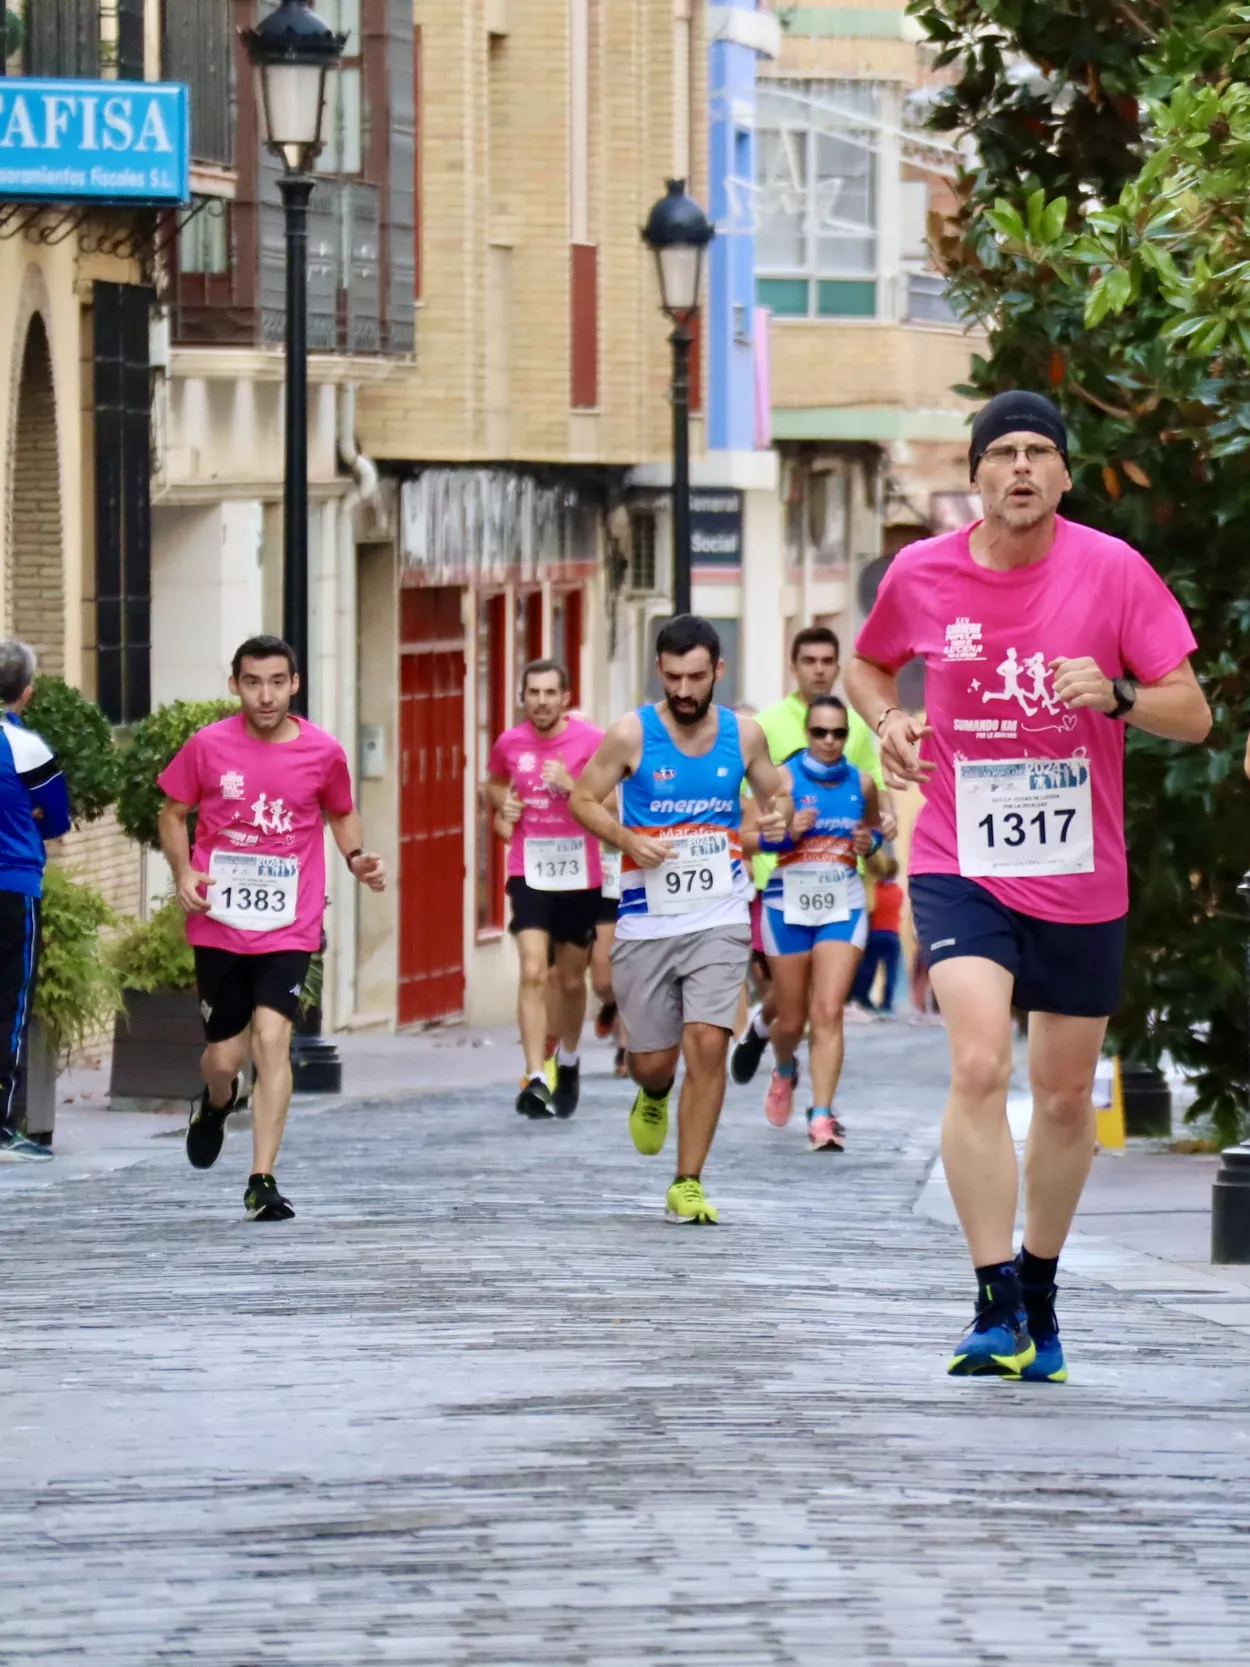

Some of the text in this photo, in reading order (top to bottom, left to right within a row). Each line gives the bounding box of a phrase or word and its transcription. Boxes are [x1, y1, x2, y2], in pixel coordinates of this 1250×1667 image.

[90, 166, 145, 187] Fiscales
[691, 531, 736, 552] Social
[953, 718, 1018, 732] SUMANDO KM
[1028, 762, 1060, 776] 2024
[650, 796, 734, 816] enerplus
[978, 808, 1076, 848] 1317
[534, 859, 580, 878] 1373
[665, 868, 714, 894] 979
[220, 886, 286, 913] 1383
[799, 893, 835, 911] 969
